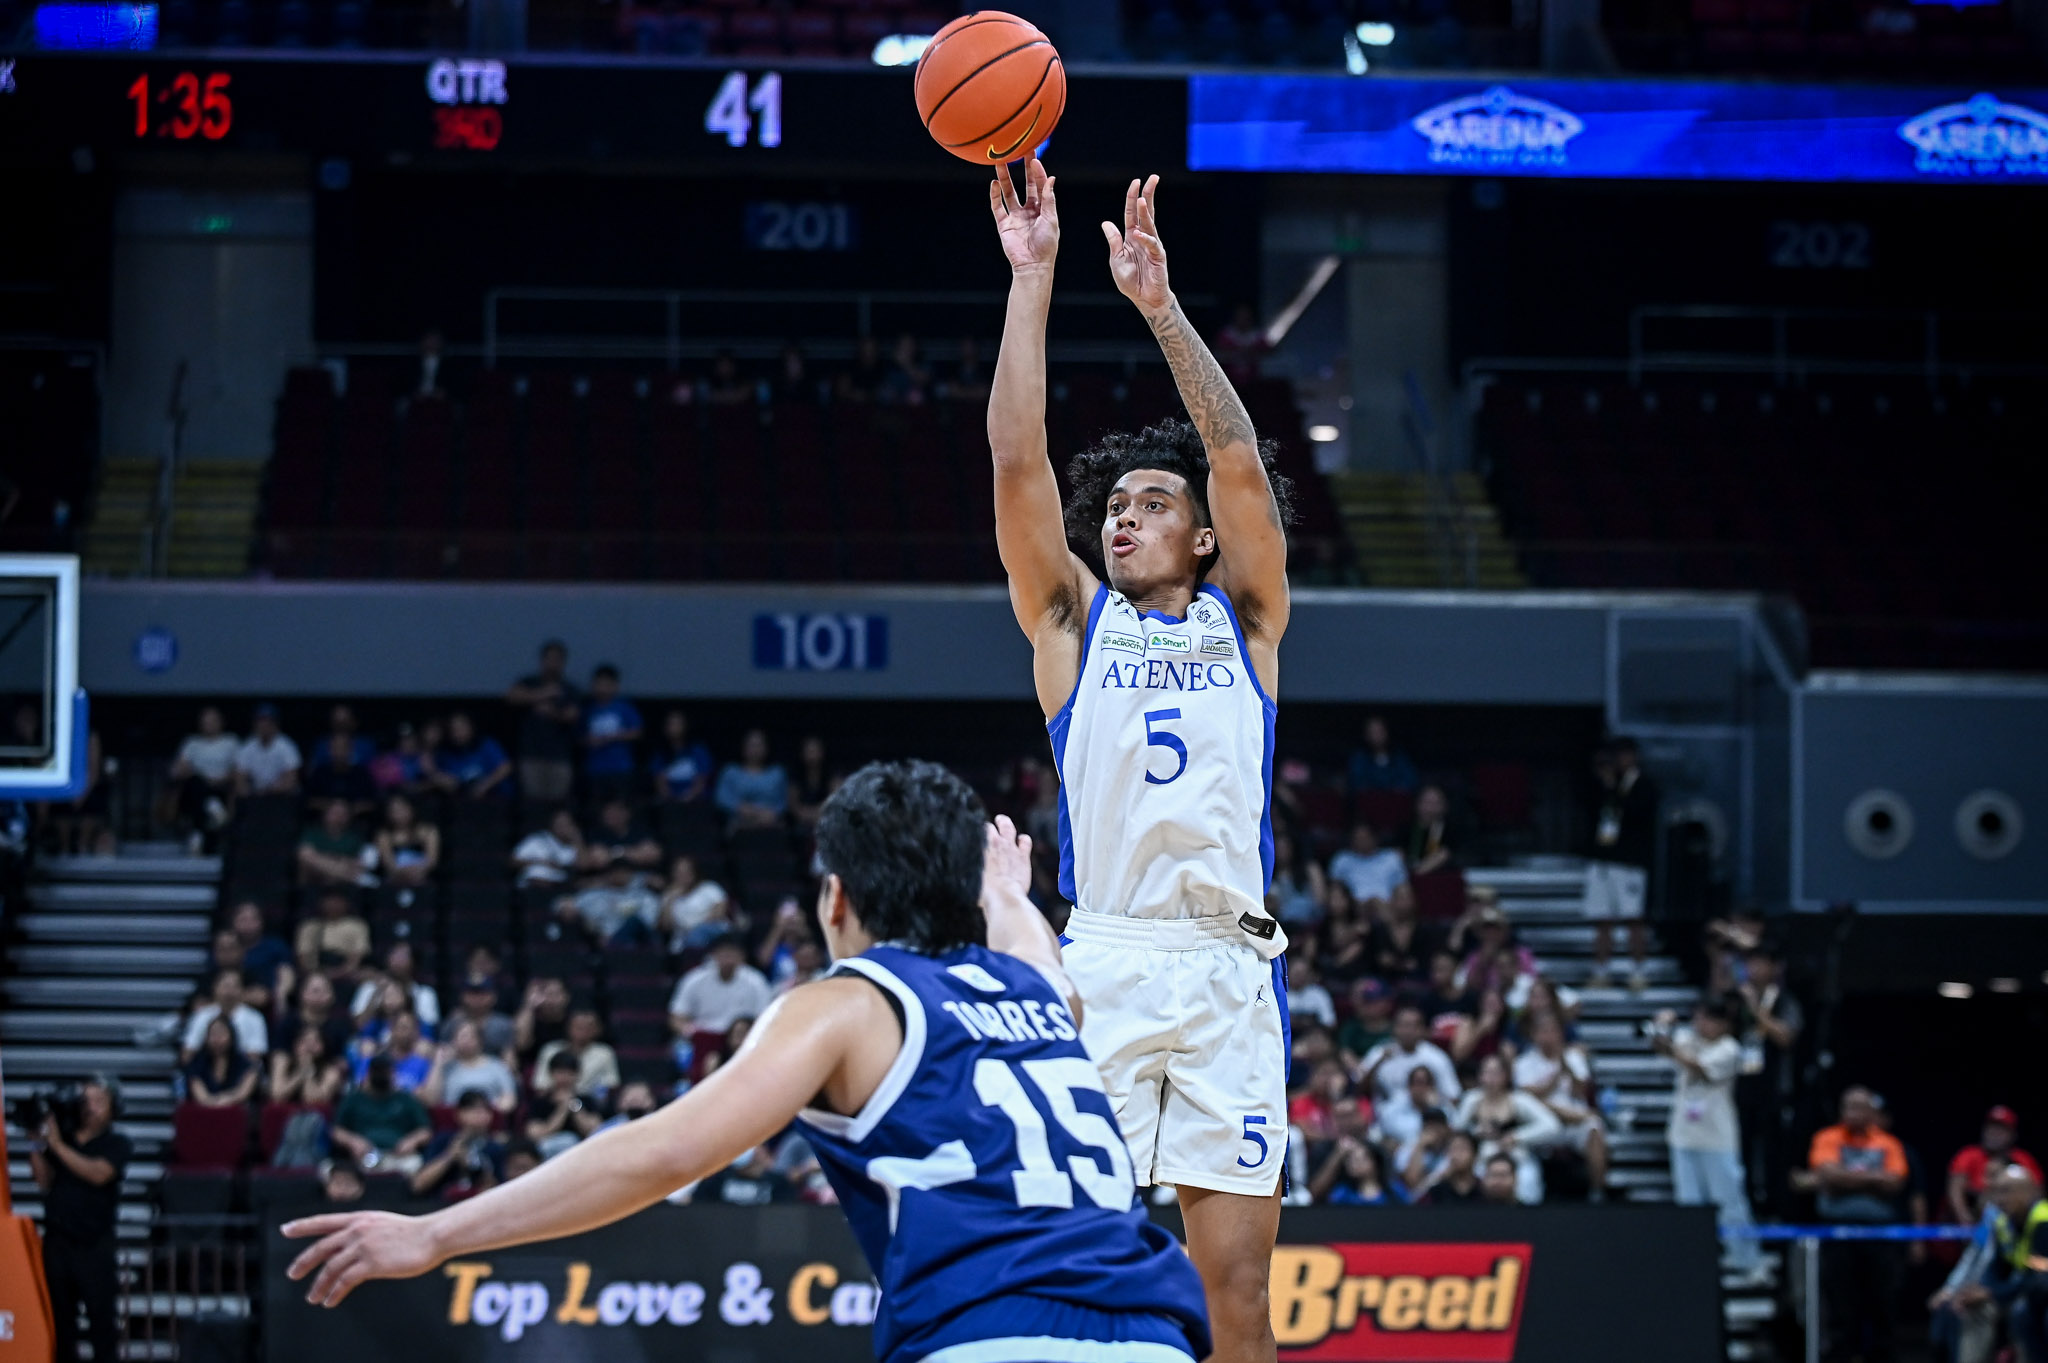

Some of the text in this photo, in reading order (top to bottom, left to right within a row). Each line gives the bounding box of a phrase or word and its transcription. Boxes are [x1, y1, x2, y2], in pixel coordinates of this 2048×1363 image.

[127, 72, 232, 140] 1:35
[425, 58, 508, 105] QTR
[704, 70, 782, 148] 41
[762, 202, 849, 250] 201
[1771, 220, 1870, 268] 202
[774, 613, 868, 670] 101
[1162, 637, 1188, 648] Smart
[1202, 644, 1234, 654] LANDMASTERS
[1101, 659, 1235, 691] ATENEO
[1144, 708, 1188, 784] 5
[941, 999, 1077, 1042] TORRES
[972, 1057, 1136, 1213] 15
[1237, 1115, 1268, 1168] 5
[443, 1261, 881, 1342] Top Love & Ca
[1268, 1244, 1522, 1345] Breed
